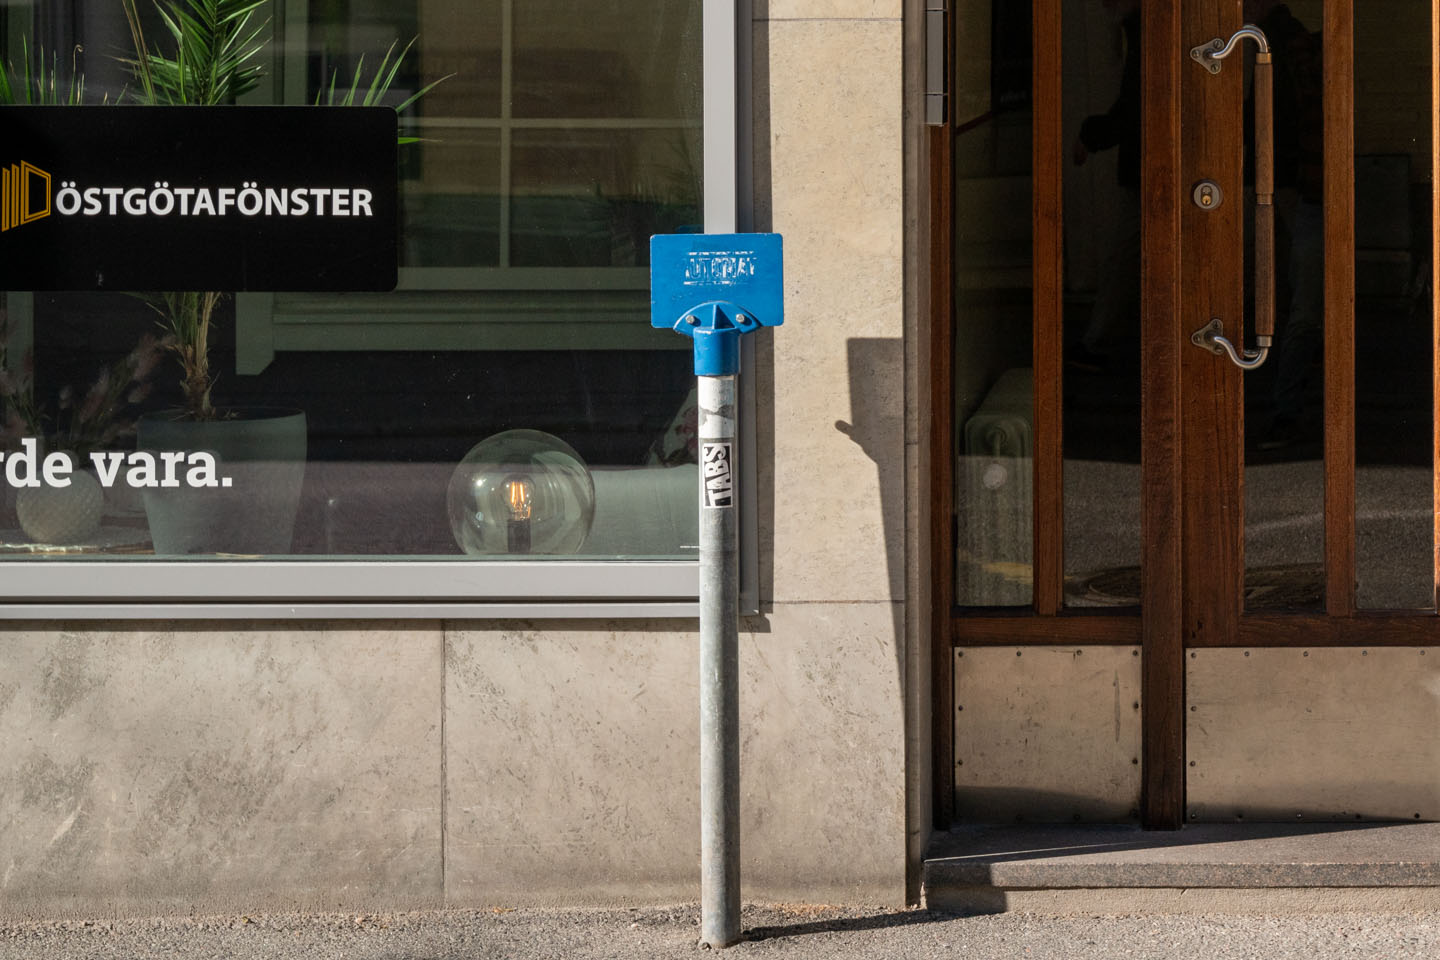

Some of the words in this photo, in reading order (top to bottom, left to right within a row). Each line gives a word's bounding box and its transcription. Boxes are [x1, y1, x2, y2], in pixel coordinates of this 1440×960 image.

[56, 181, 373, 216] ÖSTGÖTAFÖNSTER
[89, 451, 233, 488] vara.
[702, 444, 732, 507] TABS
